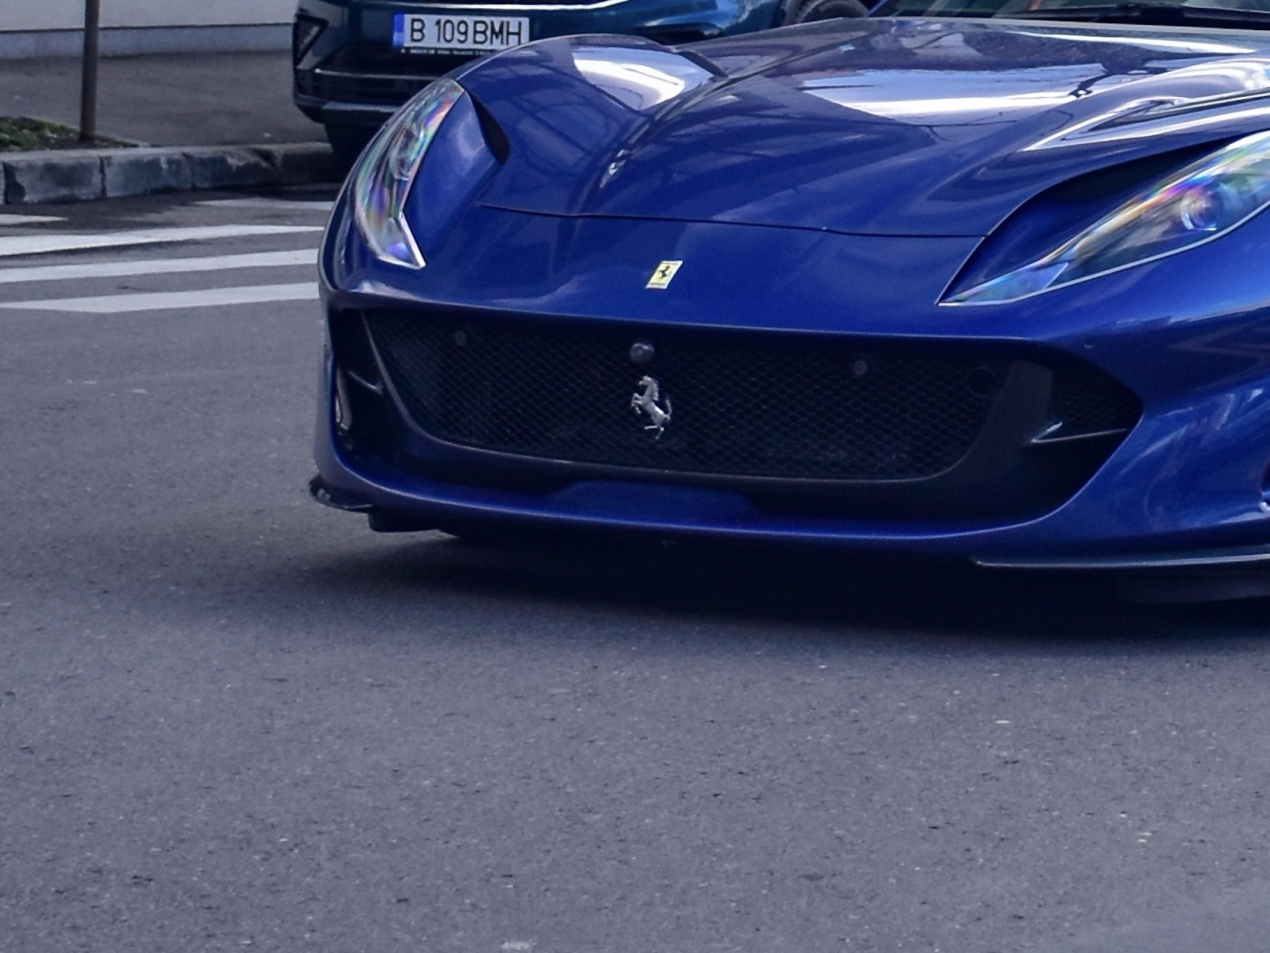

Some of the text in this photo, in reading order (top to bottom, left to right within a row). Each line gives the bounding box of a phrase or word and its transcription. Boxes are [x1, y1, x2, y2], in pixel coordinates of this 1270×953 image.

[410, 18, 523, 46] B 109 BMH
